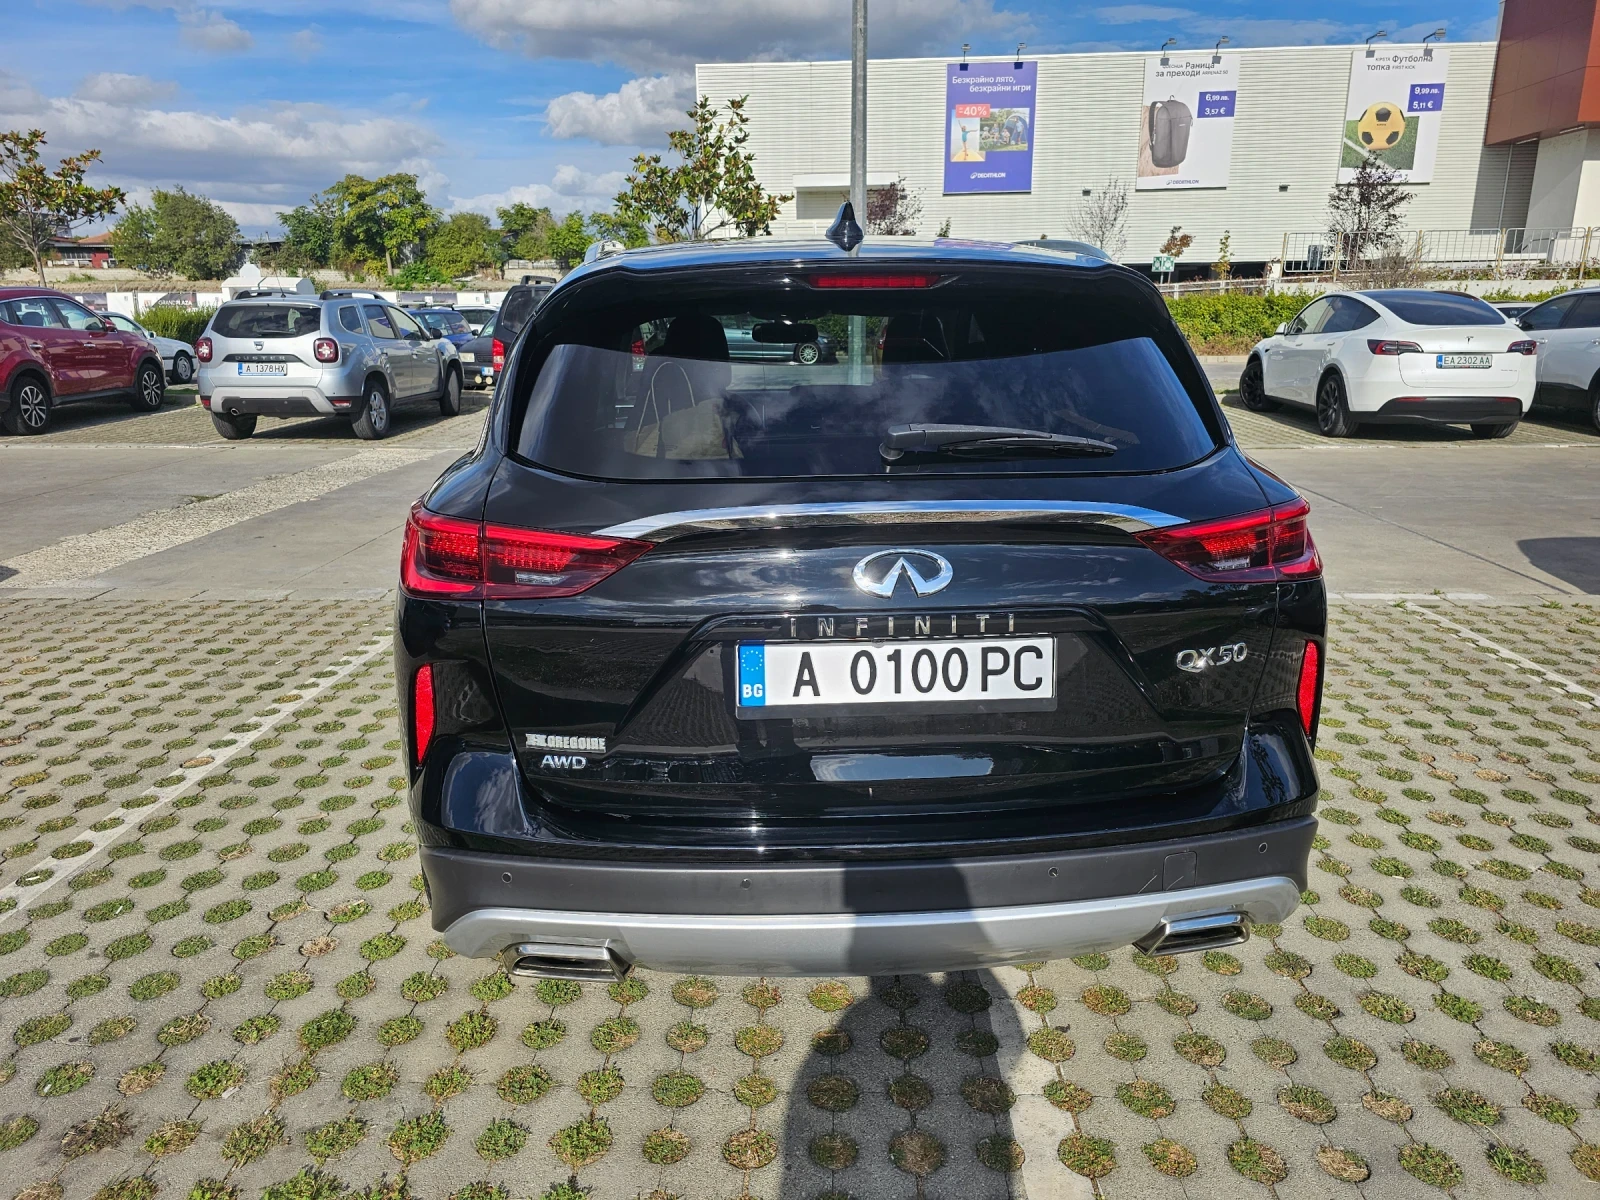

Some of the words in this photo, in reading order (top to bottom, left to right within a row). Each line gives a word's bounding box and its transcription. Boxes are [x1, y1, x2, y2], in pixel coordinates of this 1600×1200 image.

[1392, 55, 1433, 64] Футболна
[1185, 62, 1215, 70] Раница
[1166, 70, 1200, 78] преходи
[952, 75, 994, 85] Безкрайно
[995, 76, 1016, 84] лято,
[969, 84, 1011, 94] безкрайни
[1012, 84, 1031, 93] игри
[1414, 87, 1430, 95] 9,99
[1412, 101, 1426, 110] 5,11
[1204, 107, 1219, 115] 3,57
[1443, 356, 1456, 365] EA
[1457, 356, 1478, 365] 2302
[1478, 356, 1491, 365] AA
[245, 364, 251, 373] A
[255, 364, 274, 373] 1378
[274, 364, 285, 373] HX
[789, 613, 1014, 637] INFINITI
[1176, 642, 1248, 673] QX50
[792, 651, 821, 697] A
[849, 647, 968, 695] 0100
[980, 645, 1043, 692] PC
[742, 684, 763, 698] BG
[540, 754, 587, 770] AWD
